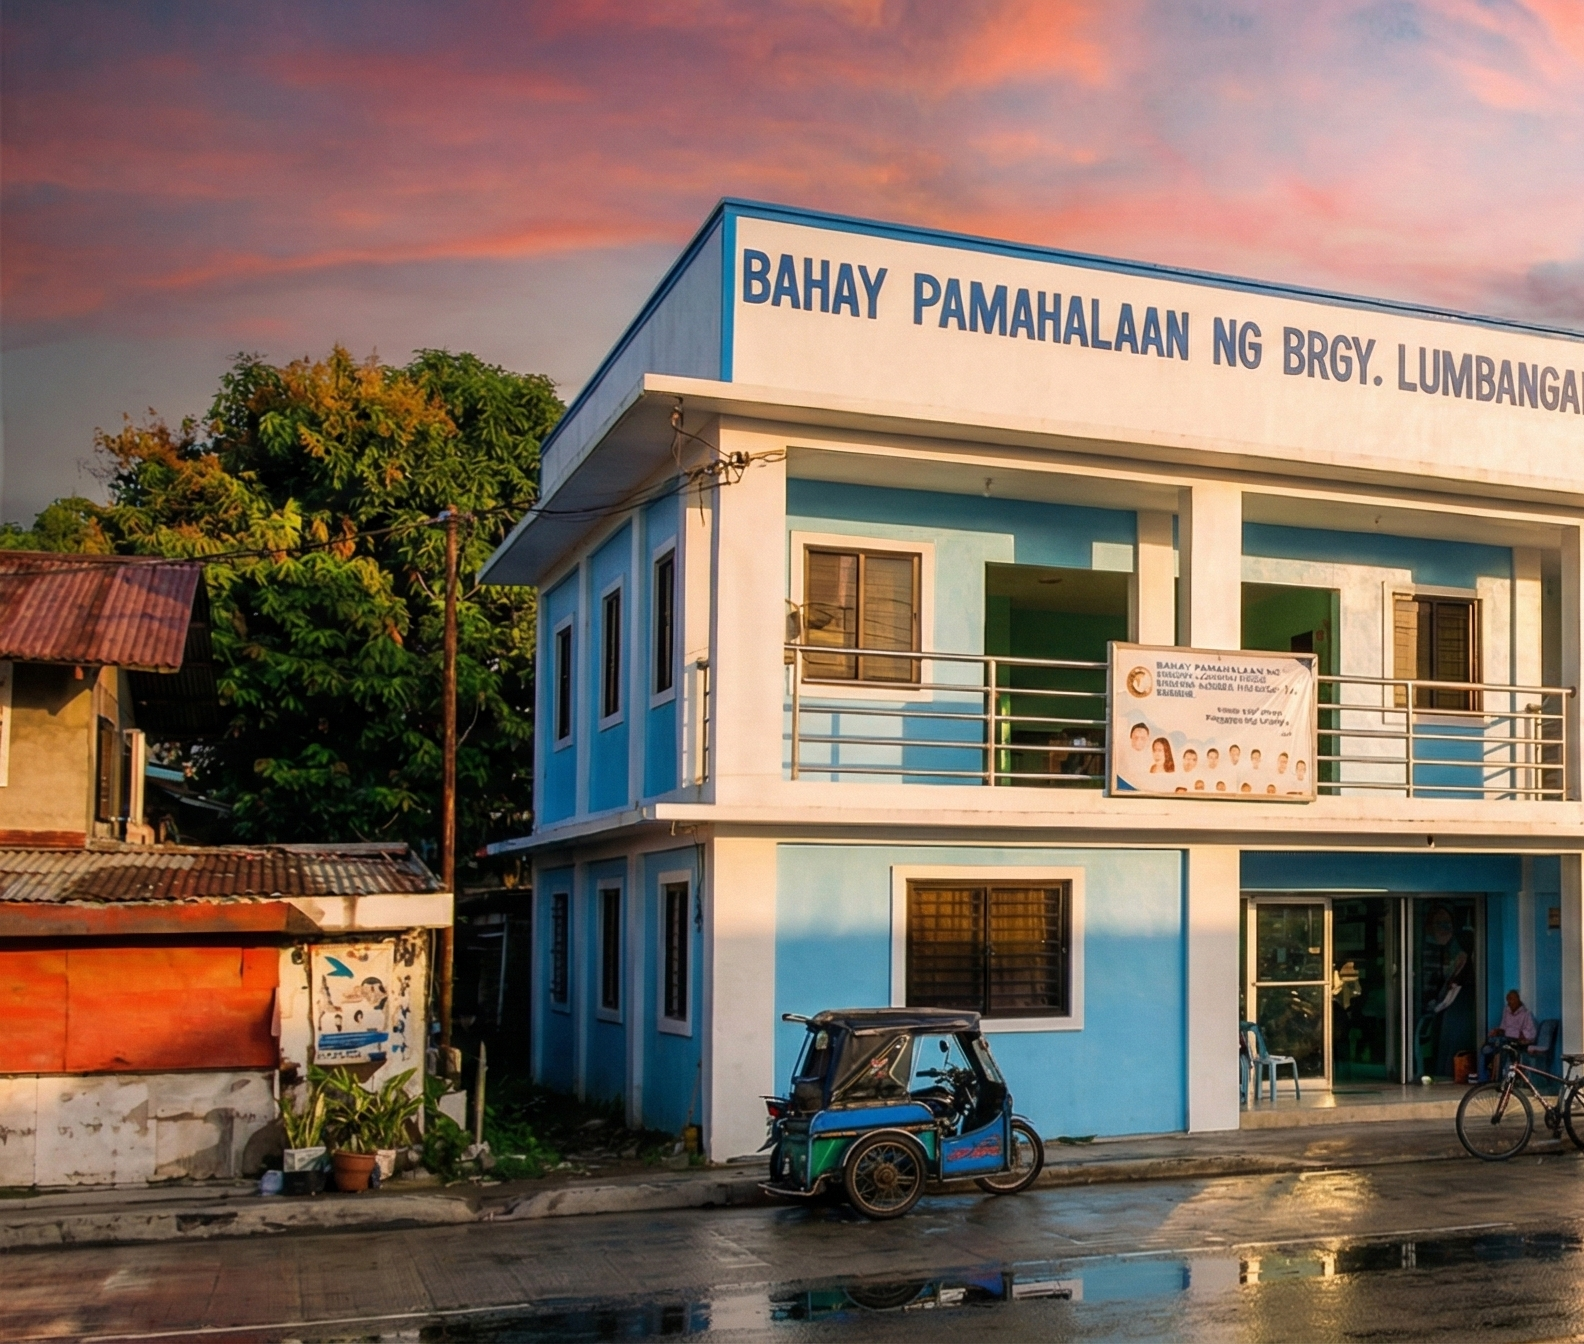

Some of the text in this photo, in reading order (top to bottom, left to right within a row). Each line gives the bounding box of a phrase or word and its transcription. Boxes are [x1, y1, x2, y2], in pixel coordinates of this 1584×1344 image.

[742, 248, 888, 320] BAHAY
[913, 272, 1189, 361] PAMAHALAAN
[1213, 316, 1262, 370] NG
[1283, 326, 1383, 387] BRGY.
